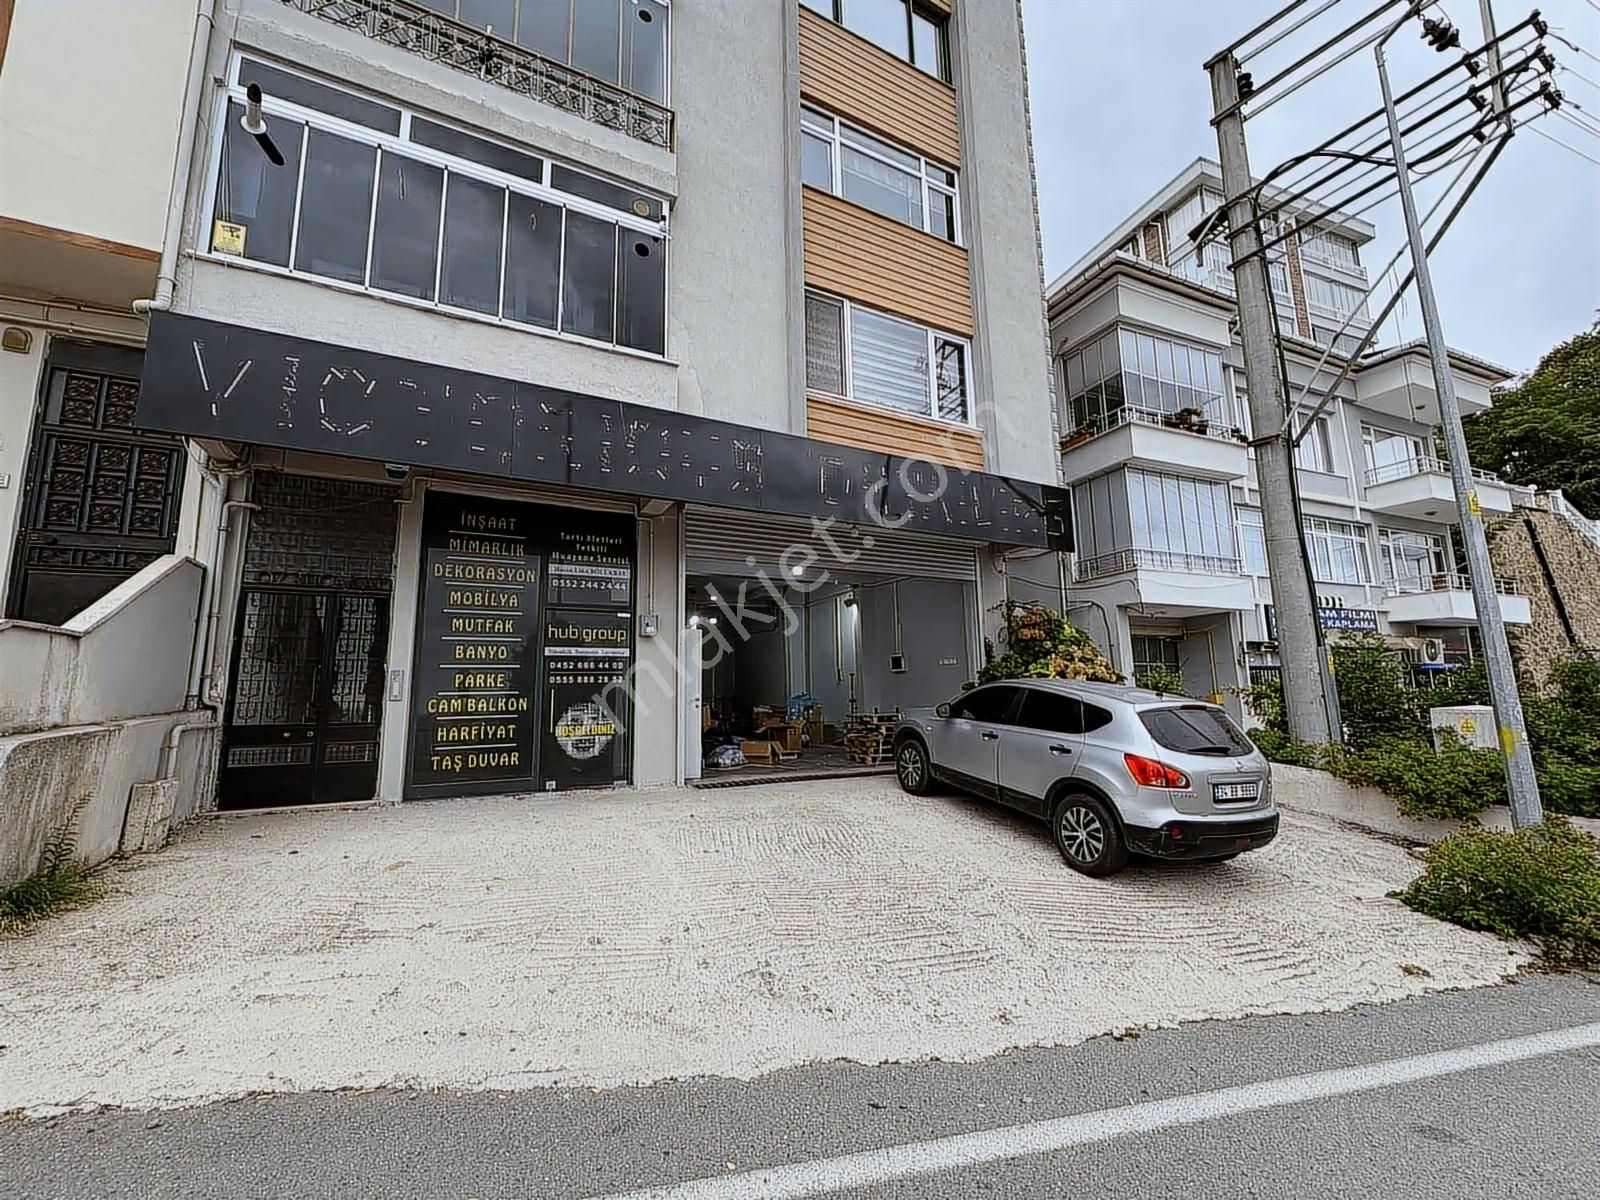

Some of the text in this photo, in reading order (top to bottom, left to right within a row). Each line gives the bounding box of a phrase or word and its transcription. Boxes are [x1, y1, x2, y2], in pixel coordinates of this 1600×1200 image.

[461, 509, 517, 531] İNŞAAT
[449, 537, 525, 557] MİMARLIK
[434, 563, 536, 583] DEKORASYON
[449, 589, 519, 608] MOBİLYA
[451, 618, 514, 633] MUTFAK
[548, 623, 627, 643] hub group
[455, 645, 508, 659] BANYO
[454, 673, 506, 688] PARKE
[427, 697, 528, 713] CAM BALKON
[437, 721, 517, 742] HARFİYAT
[431, 752, 520, 773] TAŞ DUVAR
